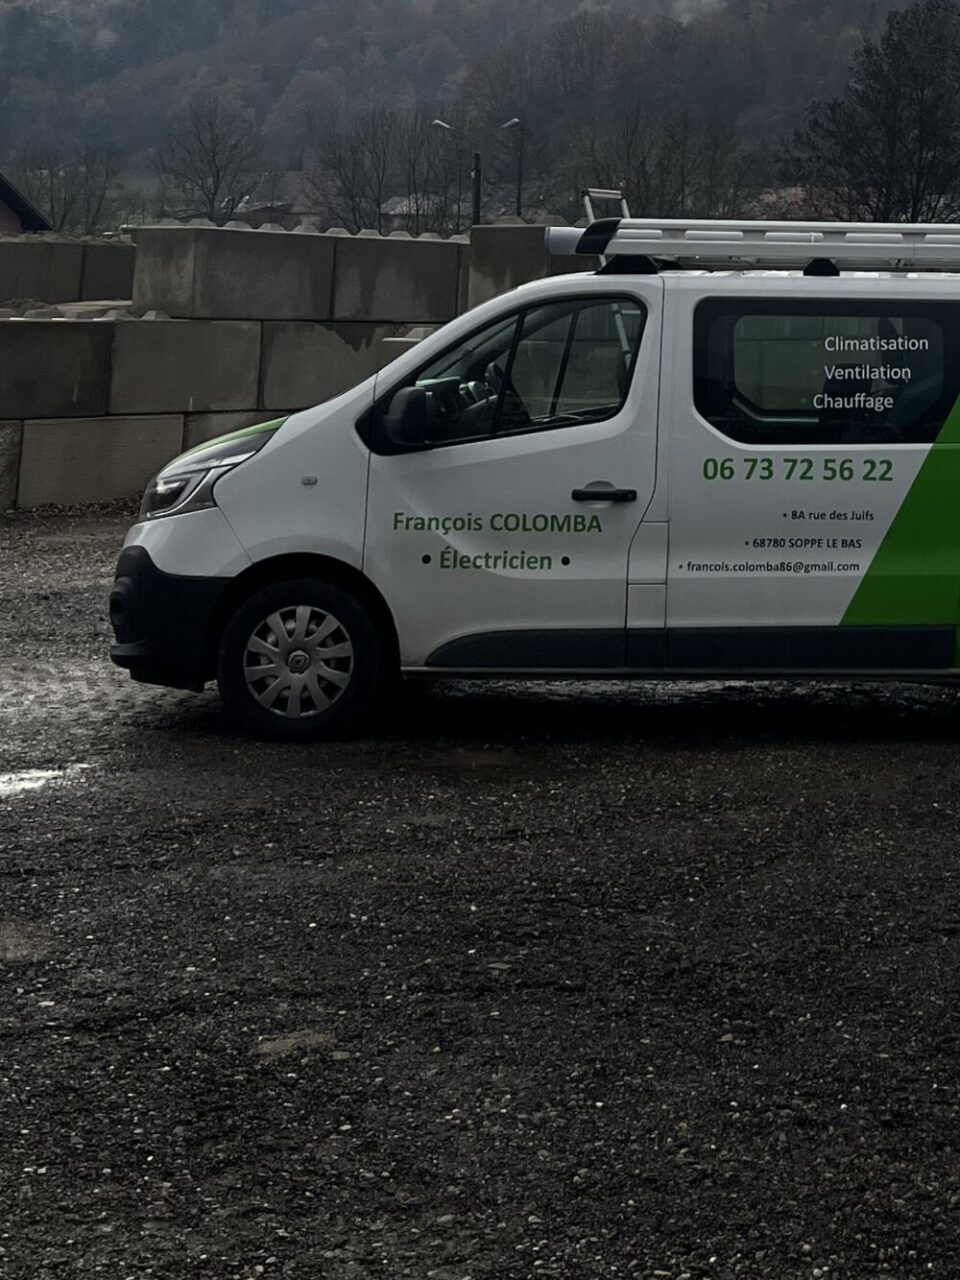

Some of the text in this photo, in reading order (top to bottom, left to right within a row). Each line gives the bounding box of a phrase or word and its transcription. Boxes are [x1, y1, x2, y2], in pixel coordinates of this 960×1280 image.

[824, 336, 929, 352] Climatisation
[824, 365, 912, 380] Ventilation
[813, 393, 894, 412] Chauffage
[703, 458, 893, 481] 06 73 72 56 22
[393, 512, 602, 535] François COLOMBA
[791, 510, 874, 522] 8A rue des Juifs
[752, 538, 862, 549] 68780 SOPPE LE BAS
[439, 546, 552, 570] Électricien
[687, 561, 860, 574] francois.colomba86@gmail.com
